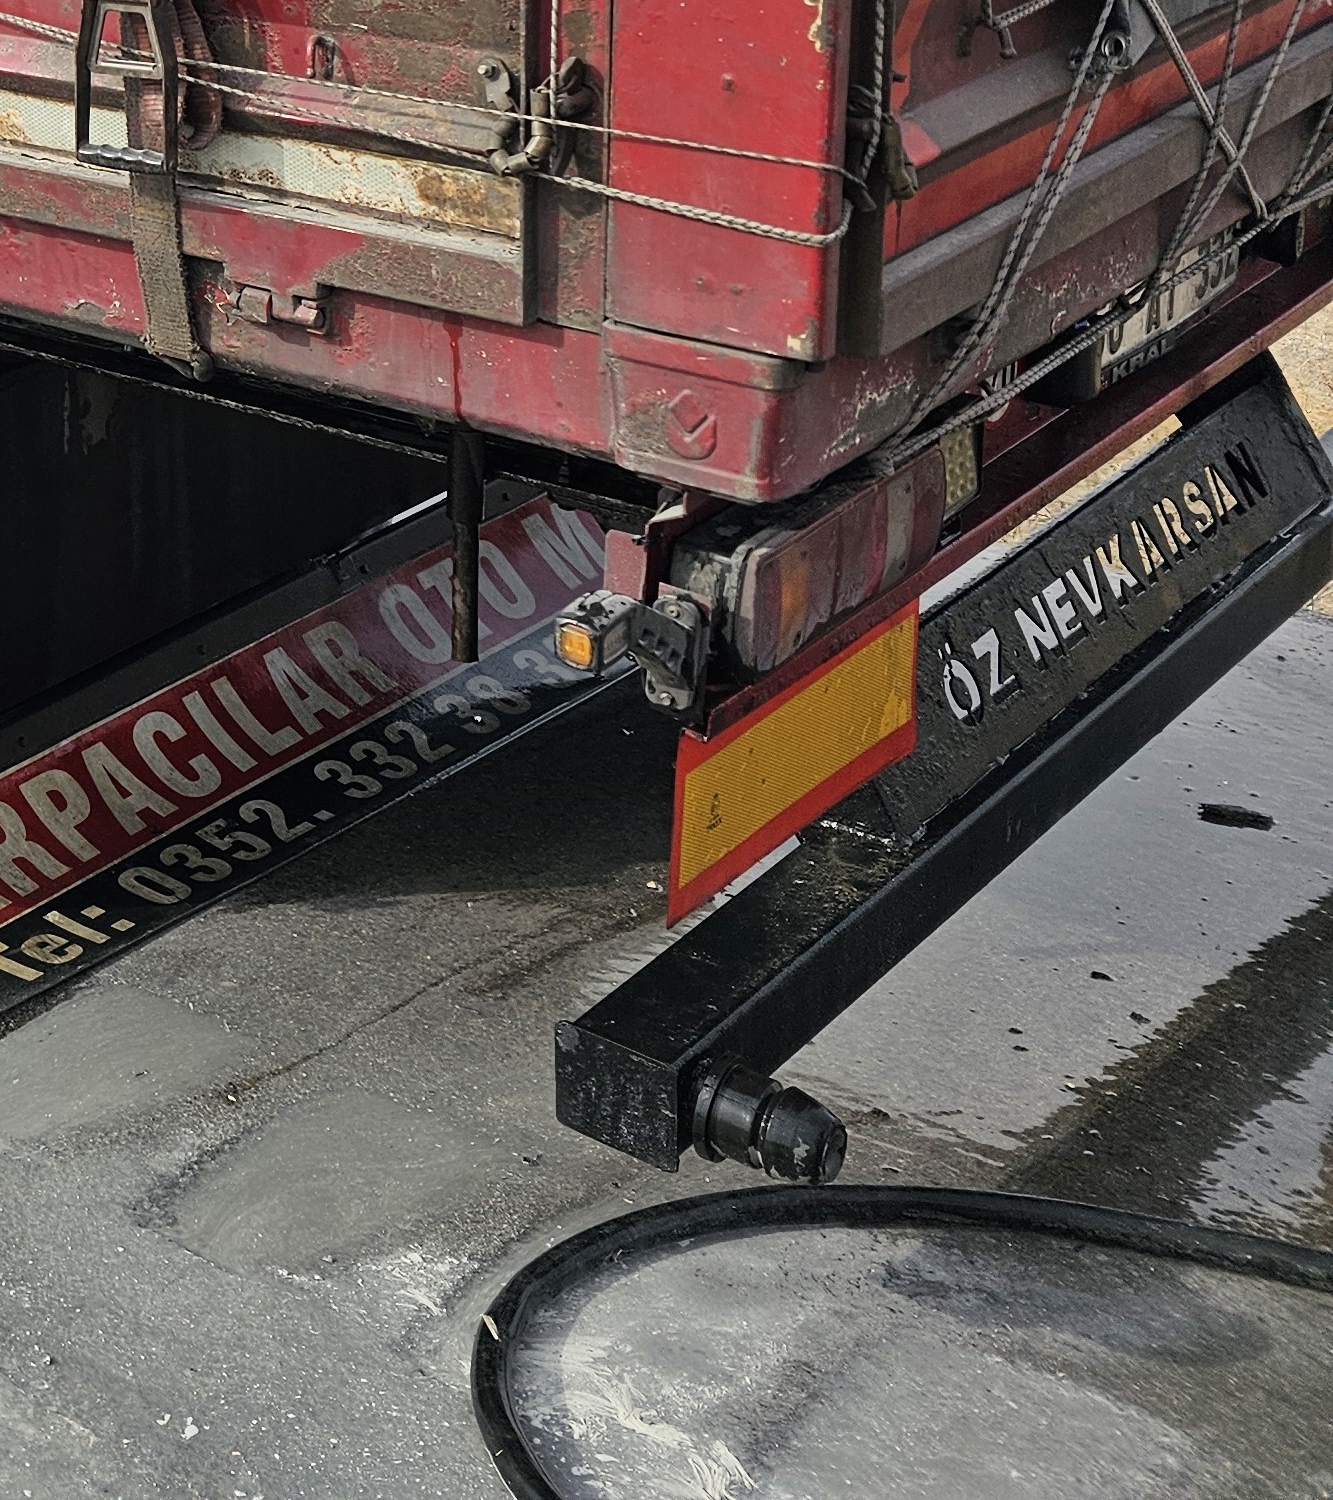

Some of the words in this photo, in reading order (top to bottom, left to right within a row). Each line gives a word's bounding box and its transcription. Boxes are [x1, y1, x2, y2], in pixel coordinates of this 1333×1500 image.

[378, 538, 537, 665] OTO
[519, 502, 606, 591] M
[937, 626, 1022, 726] ÖZ
[1013, 442, 1270, 668] NEVKARSAN
[117, 799, 336, 905] 0352.
[313, 720, 457, 799] 332
[432, 675, 532, 734] 38
